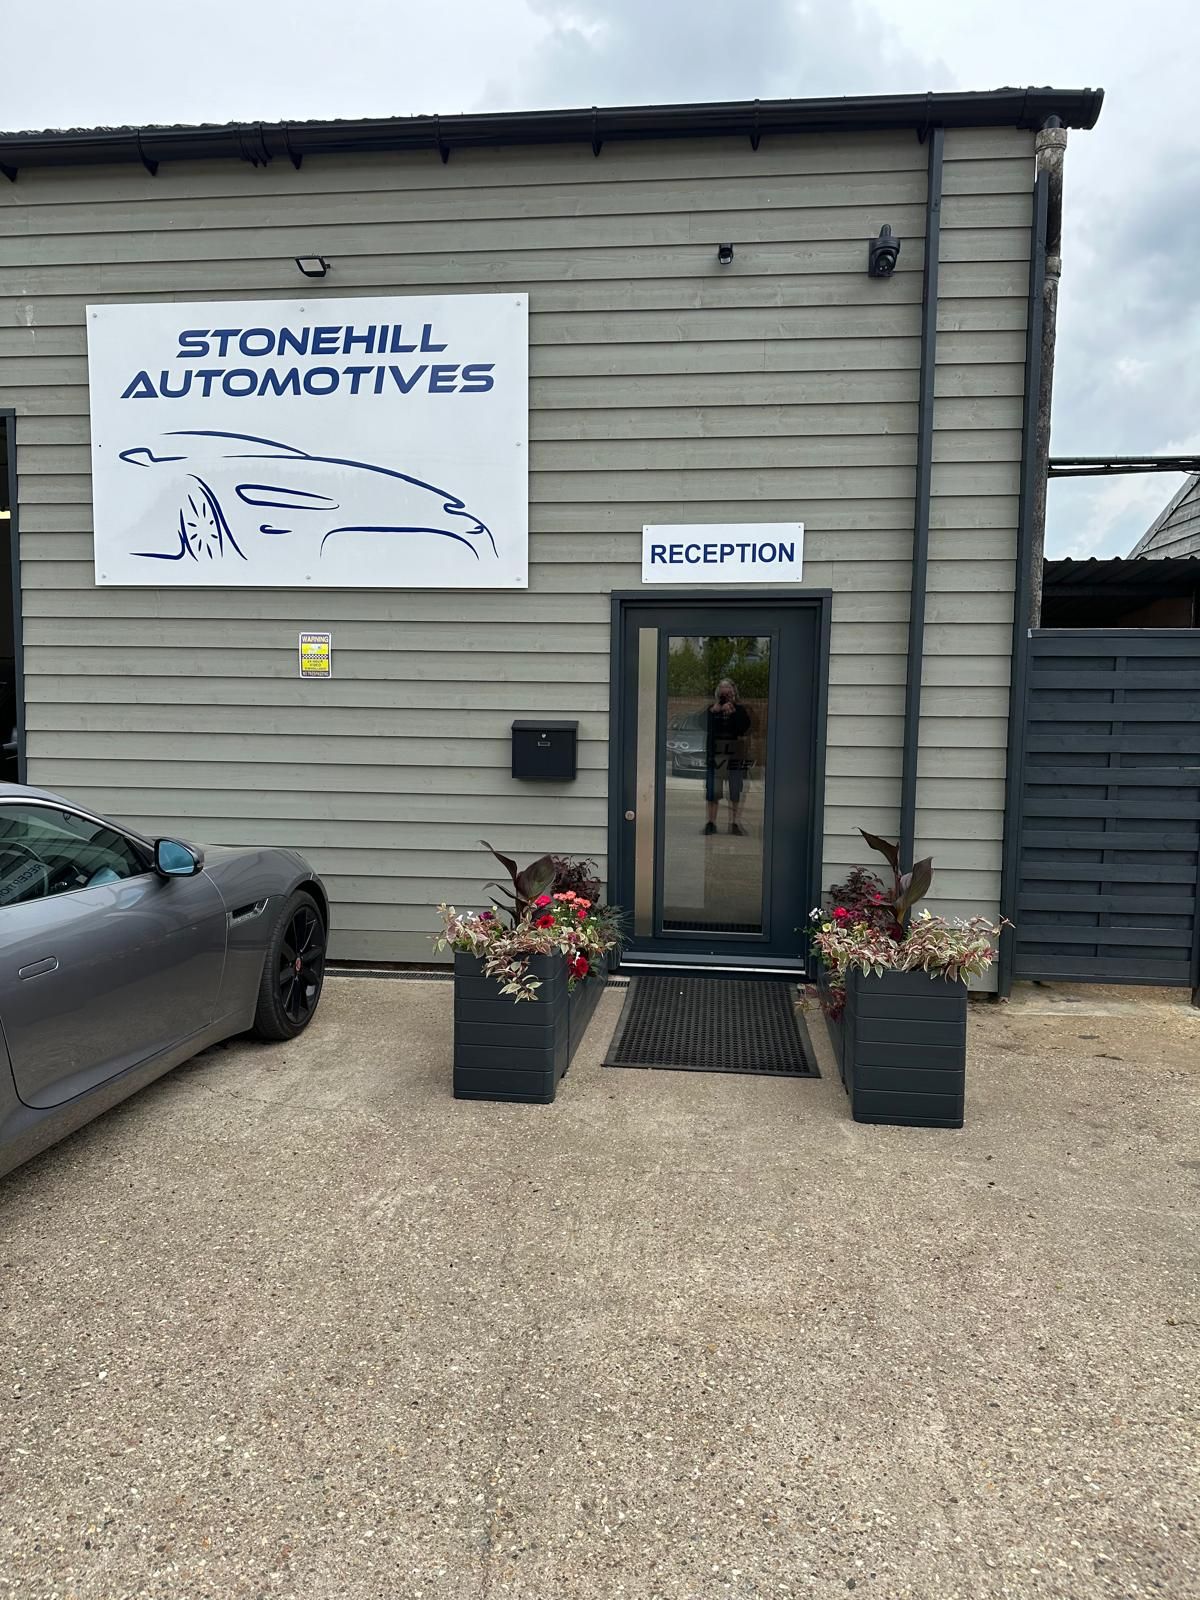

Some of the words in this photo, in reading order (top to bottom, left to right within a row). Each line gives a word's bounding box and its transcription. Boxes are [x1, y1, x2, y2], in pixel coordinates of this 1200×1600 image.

[176, 324, 448, 358] STONEHILL
[121, 363, 496, 399] AUTOMOTIVES
[651, 543, 795, 564] RECEPTION
